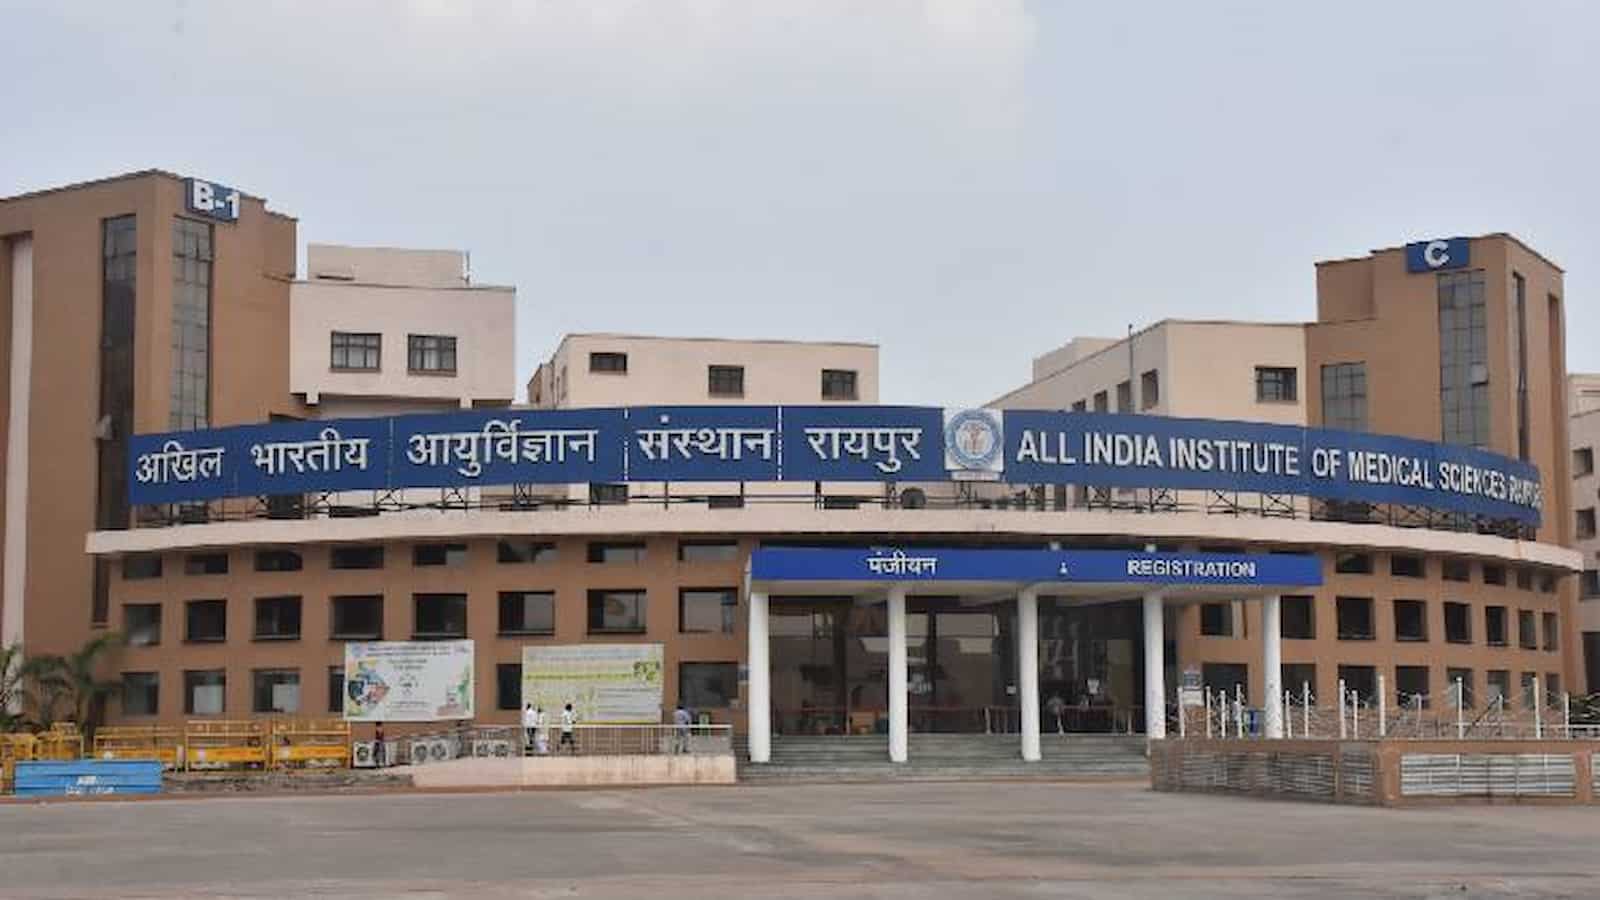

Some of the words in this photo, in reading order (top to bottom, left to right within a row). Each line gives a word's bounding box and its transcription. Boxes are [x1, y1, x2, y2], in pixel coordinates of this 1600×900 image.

[193, 181, 240, 219] B-1
[1424, 240, 1449, 268] C
[135, 440, 225, 483] अखिल
[251, 428, 370, 475] भारतीय
[406, 419, 599, 477] आयुर्विज्ञान
[636, 414, 776, 460] संस्थान
[804, 427, 922, 472] रायपुर
[1016, 430, 1076, 464] ALL
[1084, 432, 1165, 468] INDIA
[1169, 437, 1301, 476] INSTITUTE
[1312, 447, 1342, 478] OF
[1349, 451, 1434, 490] MEDICAL
[1439, 461, 1507, 500] SCIENCES
[866, 549, 938, 576] पंजीयन
[1127, 559, 1256, 577] REGISTRATION
